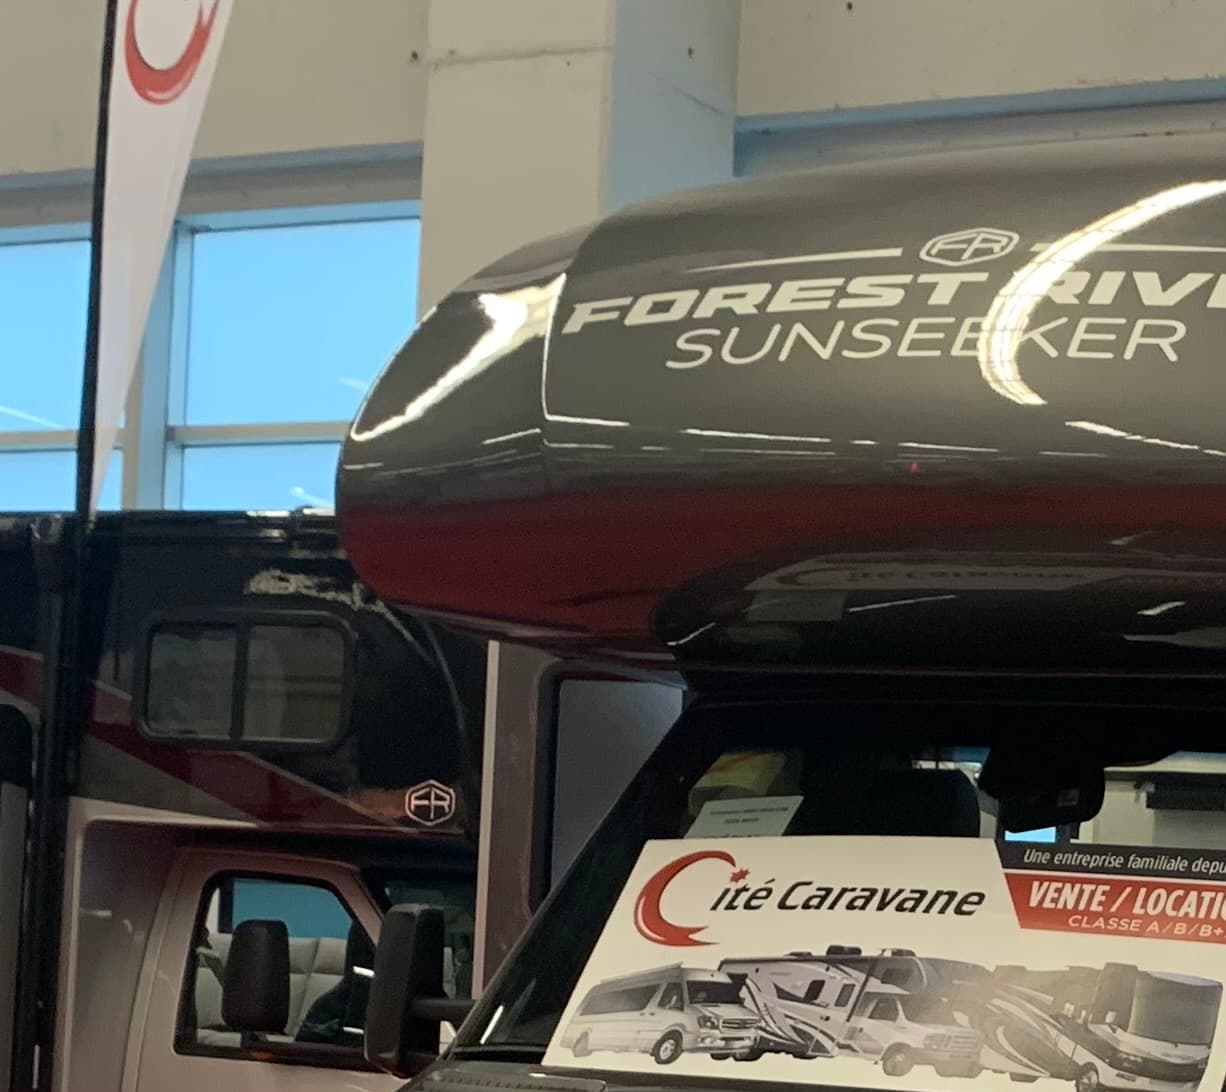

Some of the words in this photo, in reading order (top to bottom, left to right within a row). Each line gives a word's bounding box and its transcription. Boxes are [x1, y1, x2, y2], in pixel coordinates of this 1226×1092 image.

[561, 271, 990, 335] FOREST
[665, 314, 1188, 369] SUNSEEKER
[1023, 848, 1051, 864] Une
[1054, 851, 1125, 872] entreprise
[1127, 853, 1189, 872] familiale
[777, 880, 986, 916] Caravane
[1029, 880, 1110, 913] VENTE
[1068, 914, 1144, 931] CLASSE
